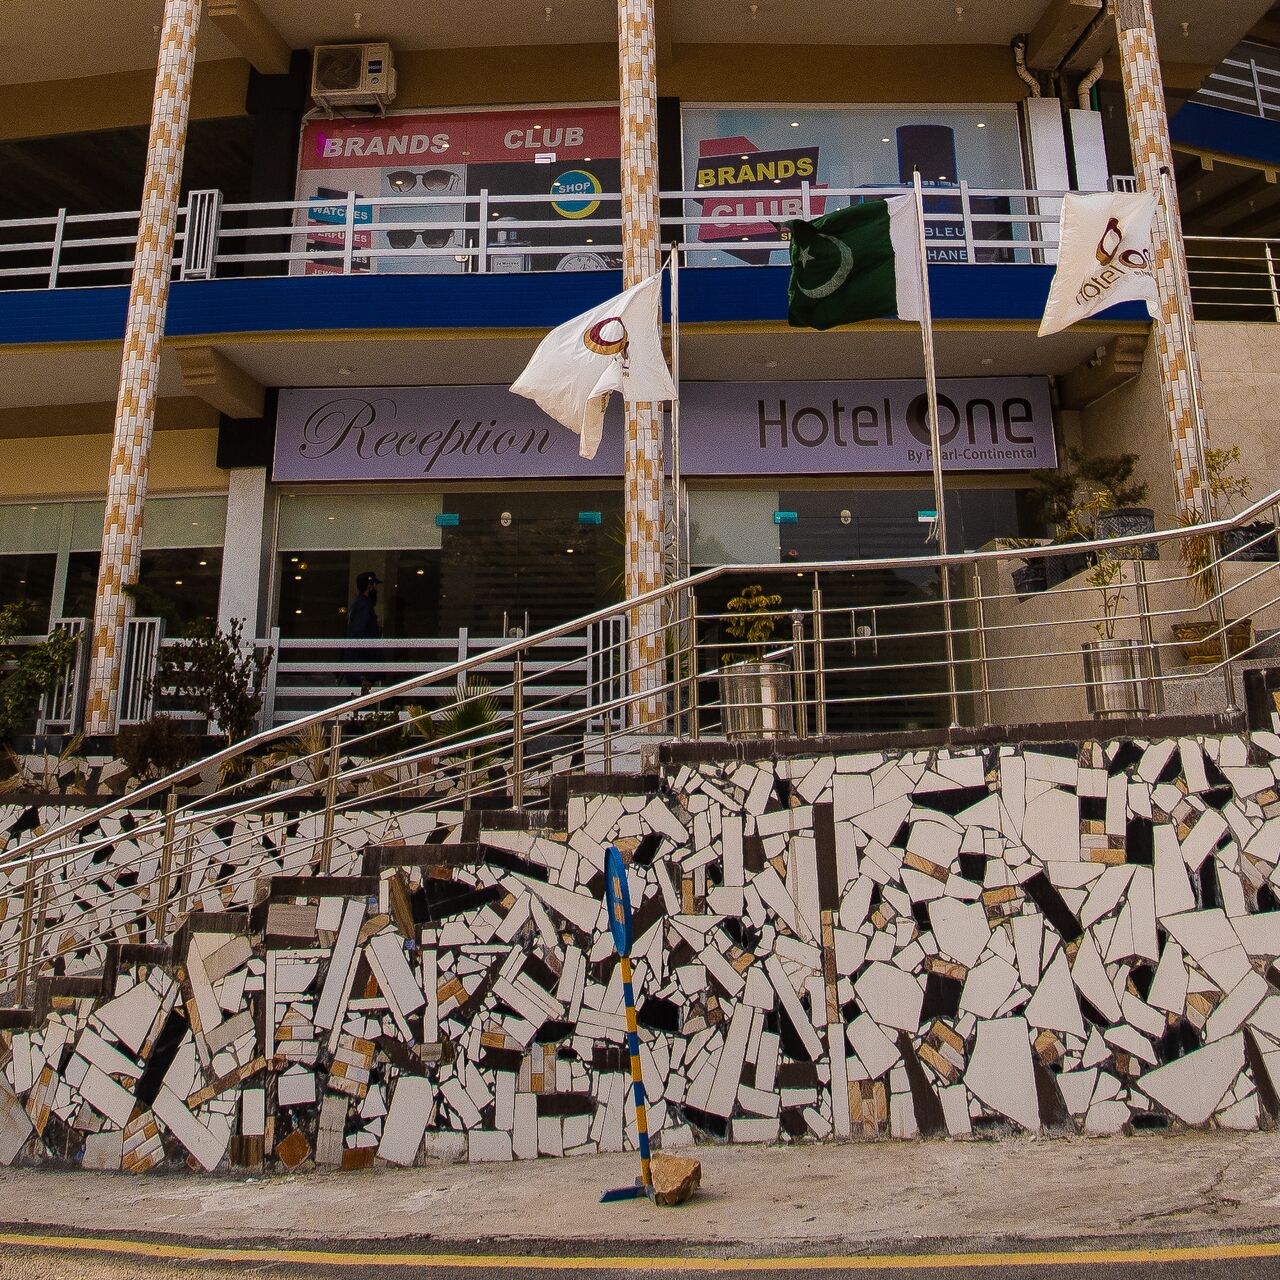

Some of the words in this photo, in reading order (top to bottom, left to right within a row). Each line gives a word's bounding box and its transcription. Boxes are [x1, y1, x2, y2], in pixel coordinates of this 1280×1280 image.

[323, 133, 450, 158] BRANDS
[503, 127, 585, 150] CLUB
[698, 157, 814, 187] BRANDS
[558, 182, 591, 194] SHOP
[312, 207, 368, 220] WATCES
[711, 199, 803, 228] CLUB
[924, 227, 965, 237] BLEU
[927, 249, 967, 261] HANE
[757, 398, 893, 448] Hotel
[906, 392, 1034, 446] One
[299, 397, 558, 473] Reception
[908, 449, 922, 464] By
[926, 447, 1037, 461] Parl-Continental
